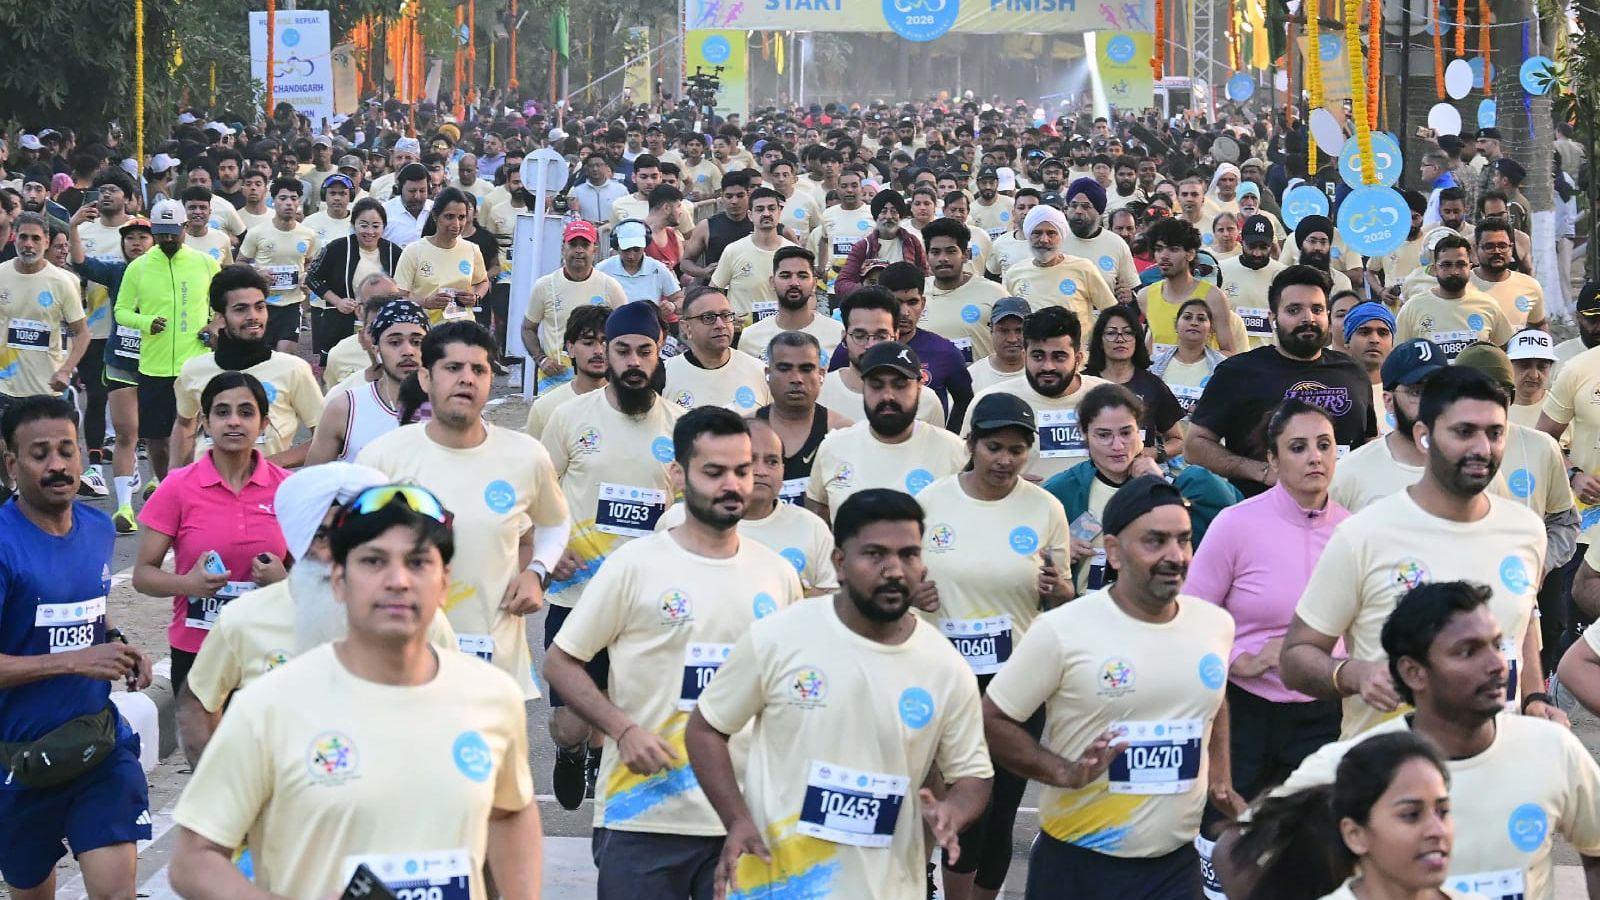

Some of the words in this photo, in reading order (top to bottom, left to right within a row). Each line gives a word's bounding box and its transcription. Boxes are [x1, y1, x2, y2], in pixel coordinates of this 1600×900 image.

[905, 15, 934, 25] 2026
[273, 83, 324, 93] CHANDIGARH
[1363, 230, 1392, 244] 2026
[1242, 317, 1264, 328] 0881
[15, 329, 40, 341] 10169
[1518, 336, 1549, 347] PING
[120, 337, 140, 348] 1504
[1050, 426, 1085, 443] 1014
[608, 502, 650, 521] 10753
[48, 624, 94, 647] 10383
[954, 637, 996, 656] 10601
[1124, 745, 1183, 770] 10470
[820, 790, 881, 821] 10453
